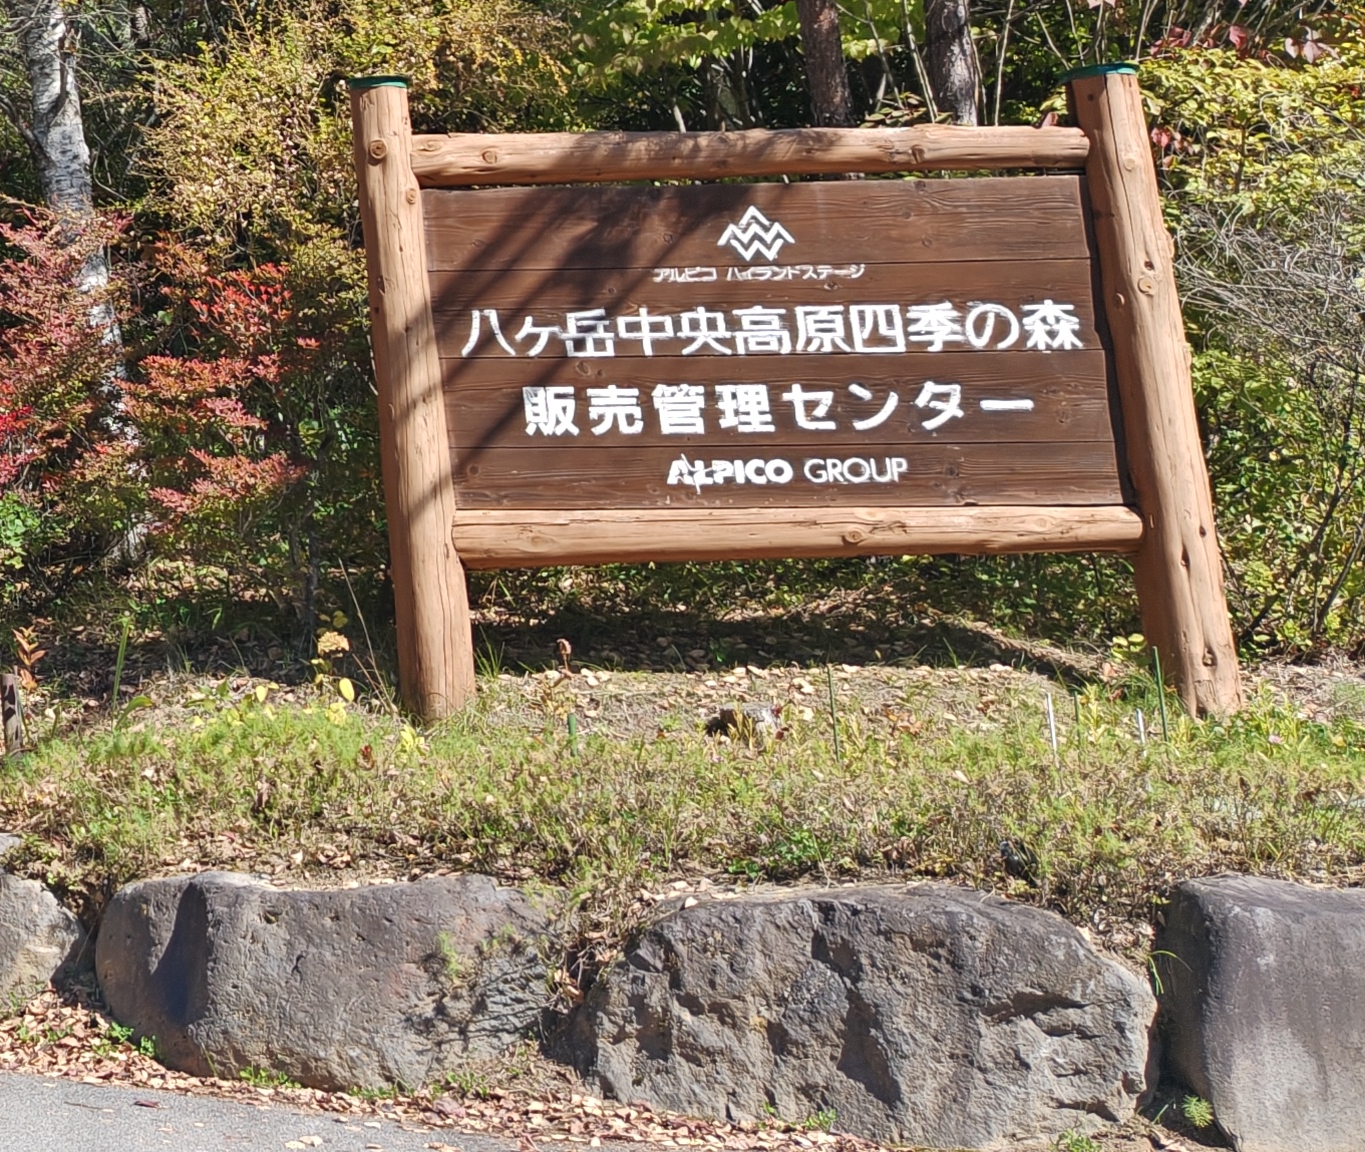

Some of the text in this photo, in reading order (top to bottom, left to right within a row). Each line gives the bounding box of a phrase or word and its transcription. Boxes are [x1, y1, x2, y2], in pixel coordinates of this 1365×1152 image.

[652, 263, 866, 283] アルピコ ハイランドステージ
[461, 299, 1083, 358] 八ヶ岳中央高原四季の森
[522, 380, 1035, 438] 販売管理センター
[667, 453, 908, 494] ALPICO GROUP
